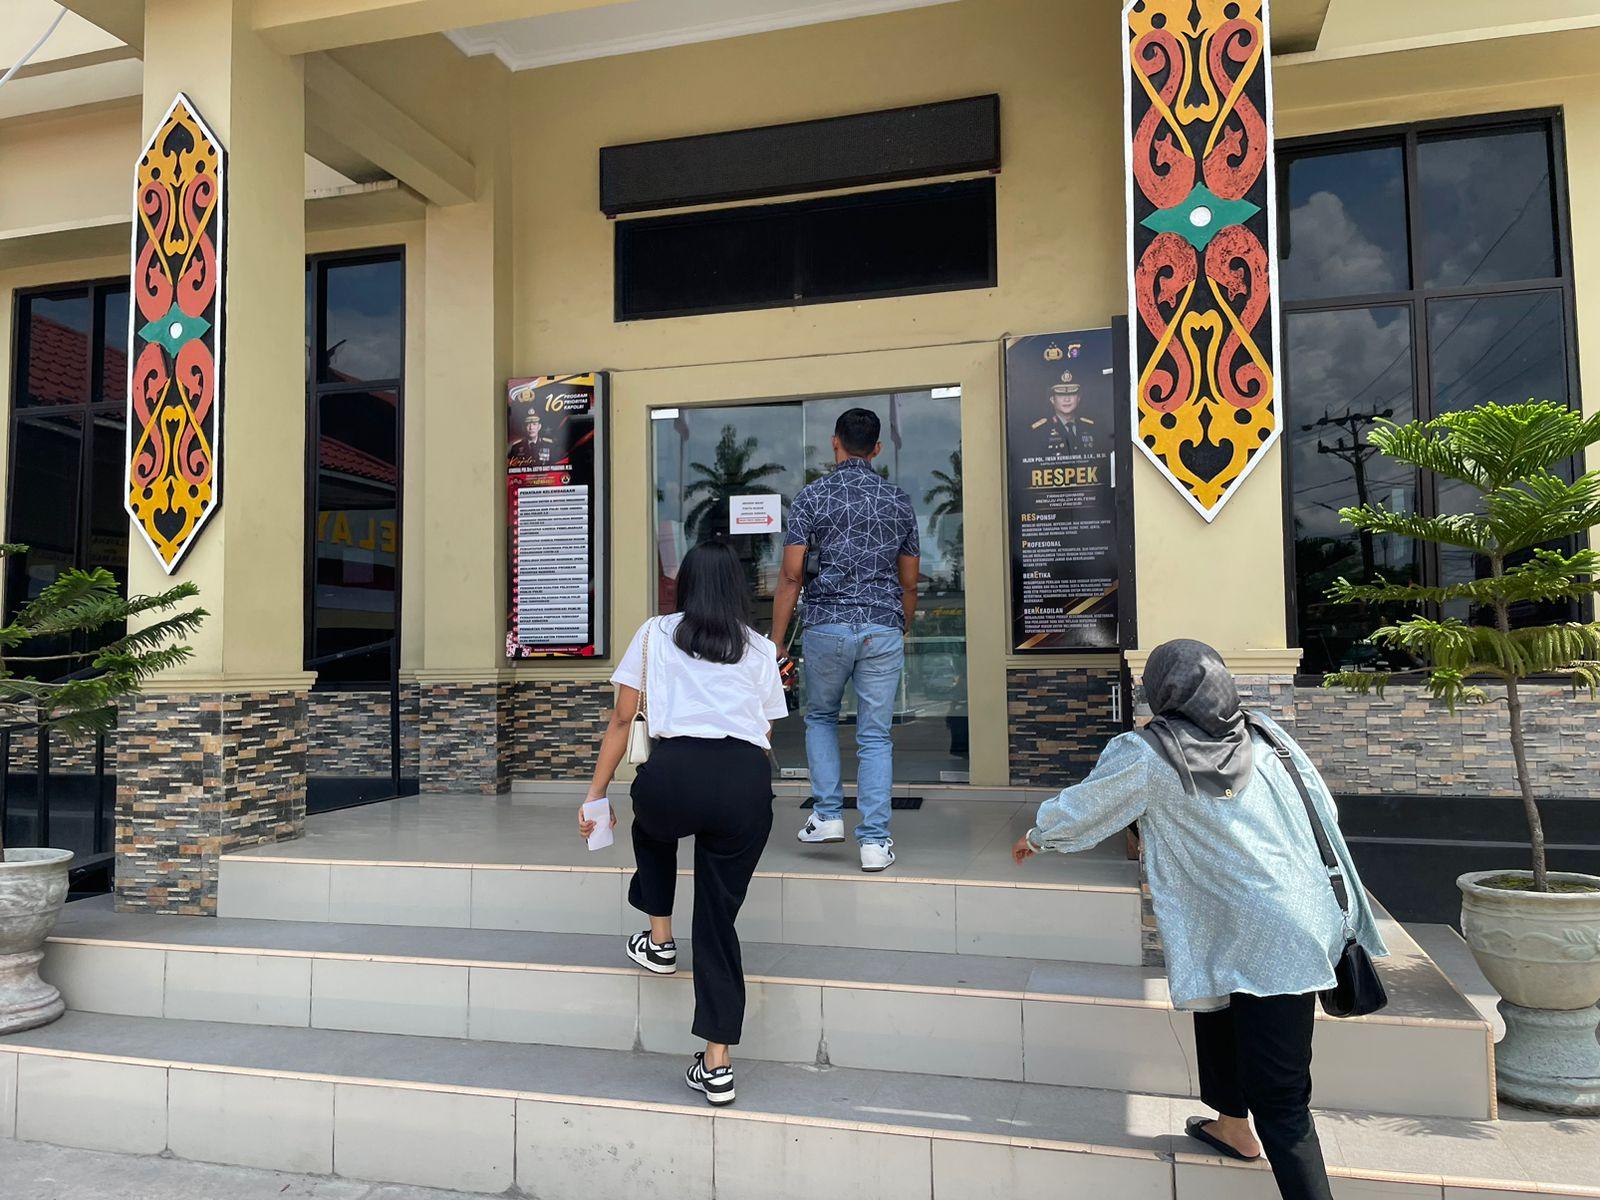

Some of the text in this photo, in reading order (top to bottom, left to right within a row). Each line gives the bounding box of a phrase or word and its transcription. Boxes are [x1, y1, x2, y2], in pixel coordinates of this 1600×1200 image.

[545, 393, 565, 412] 16
[1031, 466, 1098, 486] RESPEK
[1022, 540, 1062, 548] PROFESIONAL
